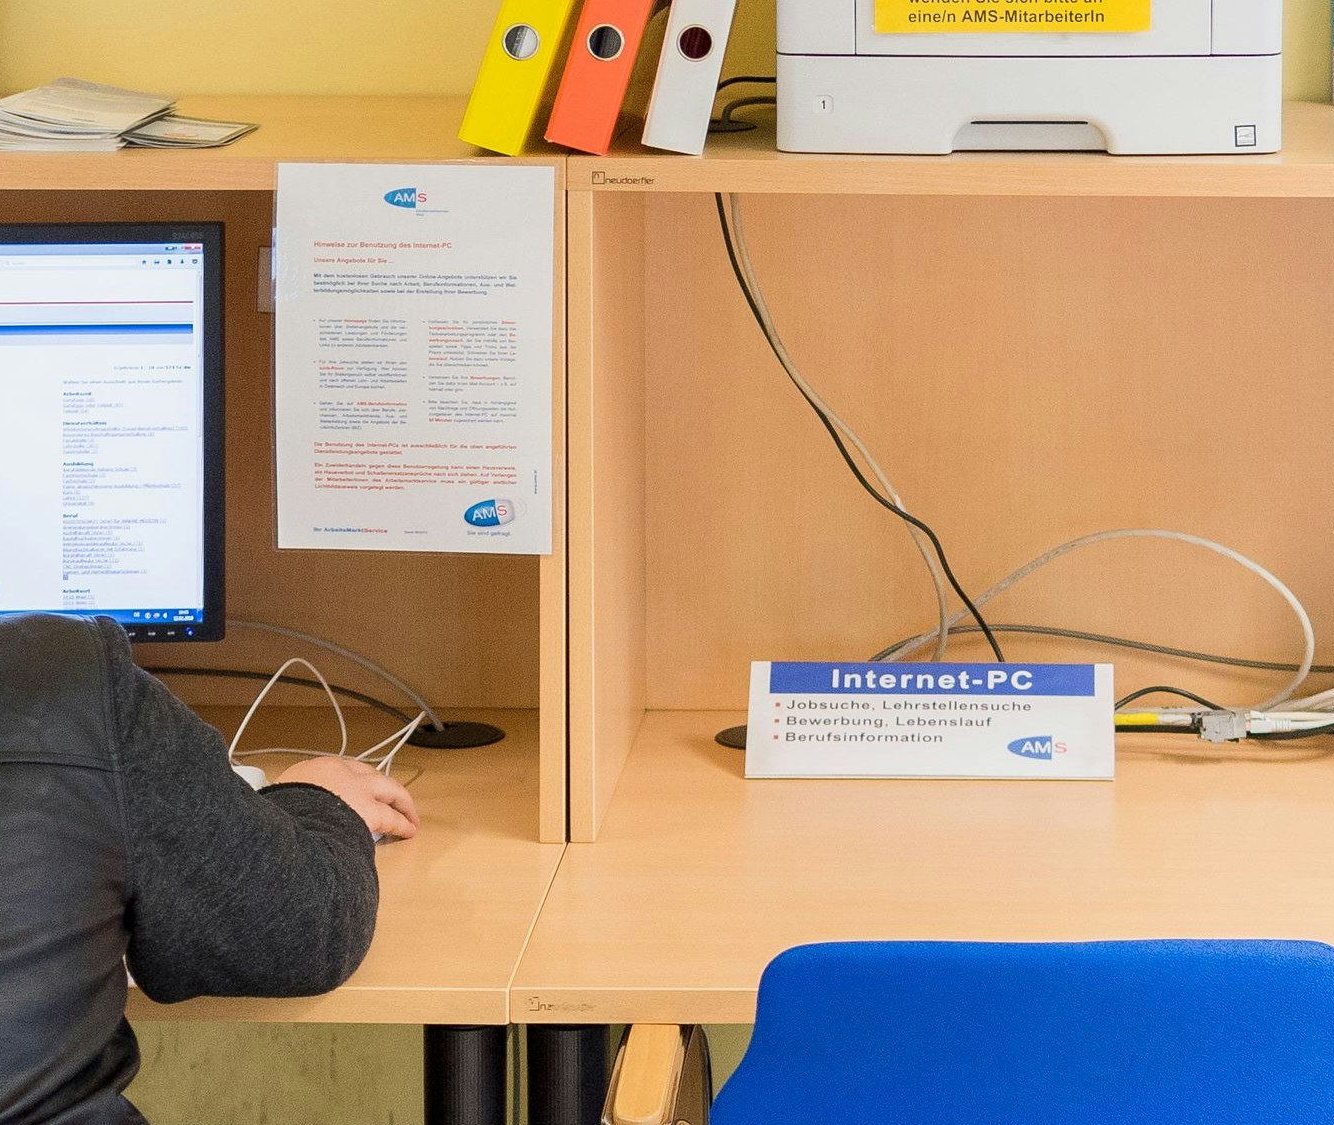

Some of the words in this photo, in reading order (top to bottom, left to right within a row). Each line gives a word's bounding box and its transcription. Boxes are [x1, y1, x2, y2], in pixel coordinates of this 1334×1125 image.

[908, 10, 955, 22] eine/n
[962, 10, 1104, 22] AMS-MitarbeiterIn
[821, 100, 827, 110] 1
[393, 193, 427, 202] AMS
[360, 241, 396, 249] Benutzung
[472, 505, 508, 521] AMS
[831, 669, 1033, 690] Internet-PC
[787, 700, 875, 711] Jobsuche,
[883, 701, 1030, 710] Lehrstellensuche
[786, 716, 889, 727] Bewerbung,
[896, 717, 990, 726] Lebenslauf
[785, 731, 943, 743] Berufsinformation
[1021, 742, 1066, 754] AMS
